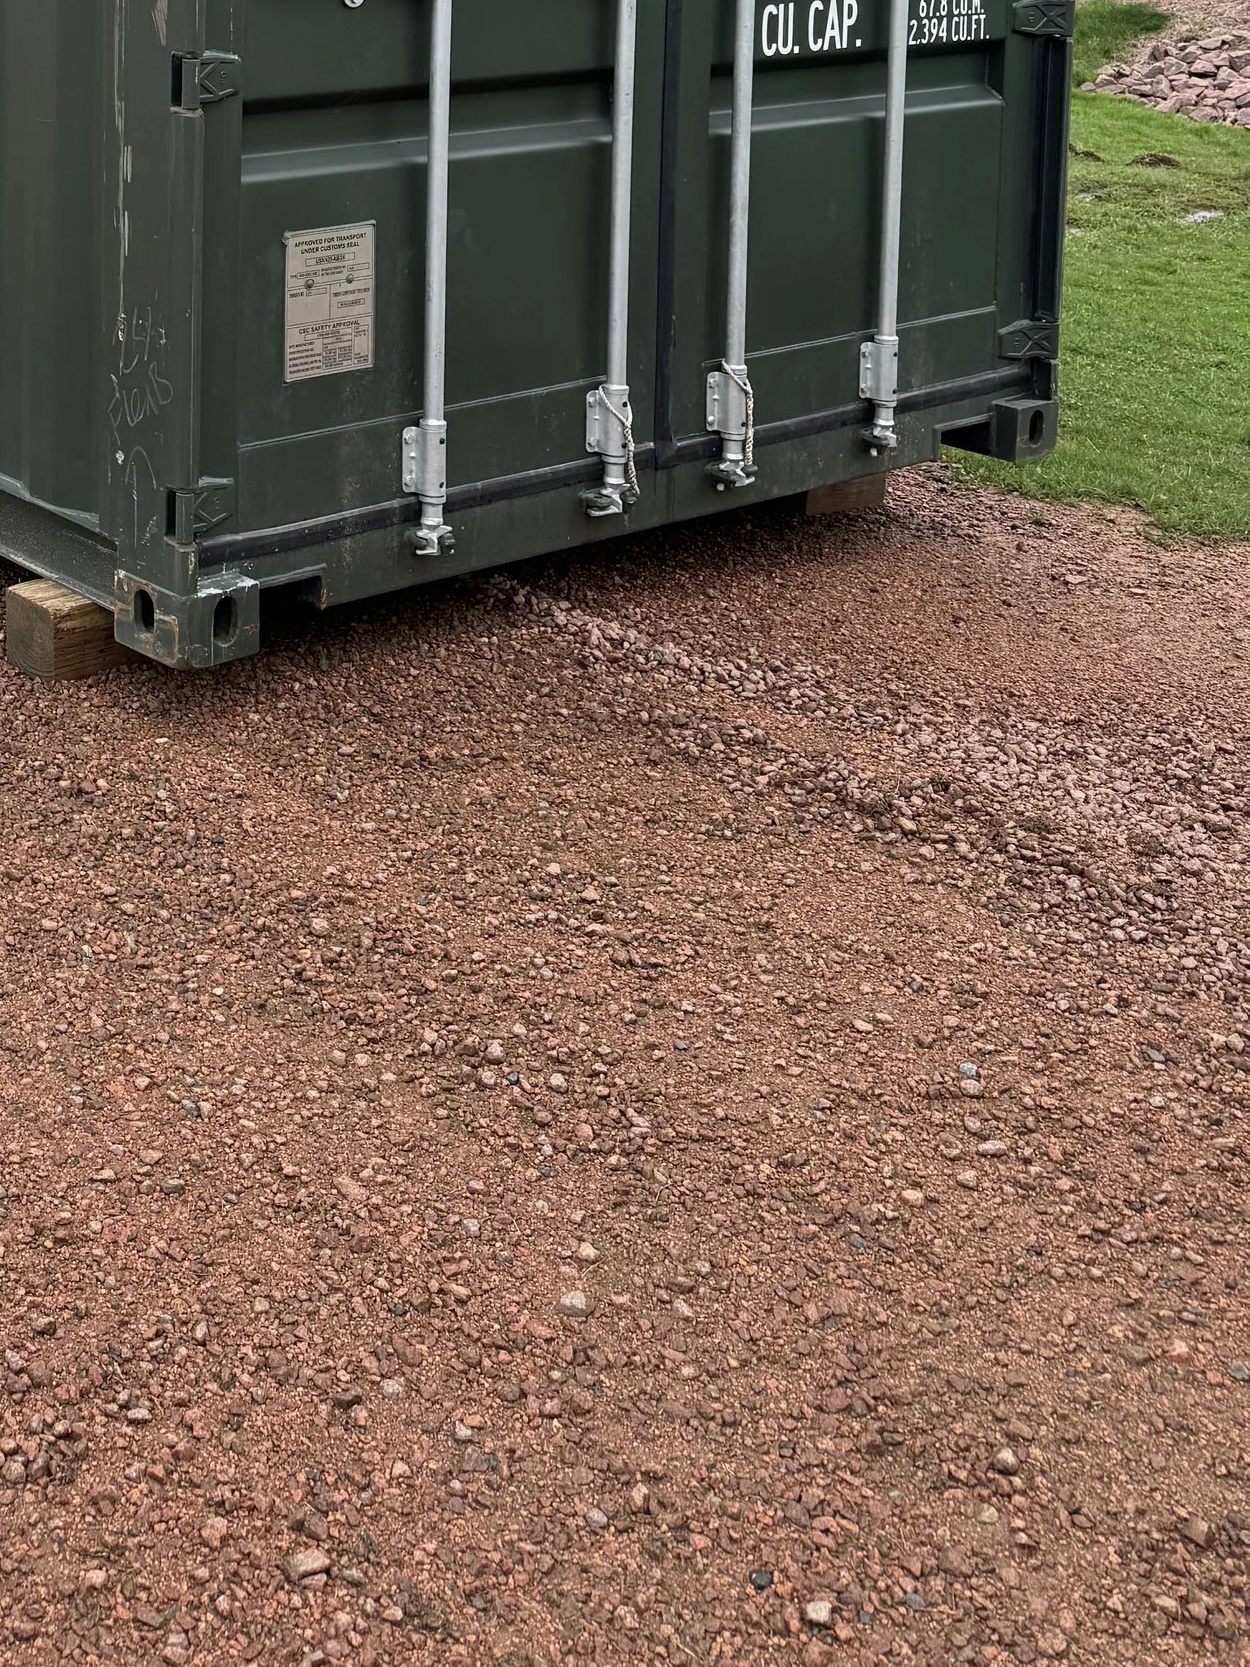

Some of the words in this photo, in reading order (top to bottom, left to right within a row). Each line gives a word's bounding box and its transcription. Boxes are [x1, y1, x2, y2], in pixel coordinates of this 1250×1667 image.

[761, 2, 800, 57] CU.
[908, 17, 947, 45] 2,394
[951, 14, 990, 42] CU.FT.
[294, 238, 323, 248] APPROVED
[336, 233, 367, 242] TRANSPORT
[300, 247, 320, 255] UNDER
[320, 243, 346, 252] CUSTOMS
[346, 241, 360, 249] SEAL
[298, 327, 310, 335] CSC
[310, 324, 332, 333] SAFETY
[332, 319, 360, 329] APPROVAL
